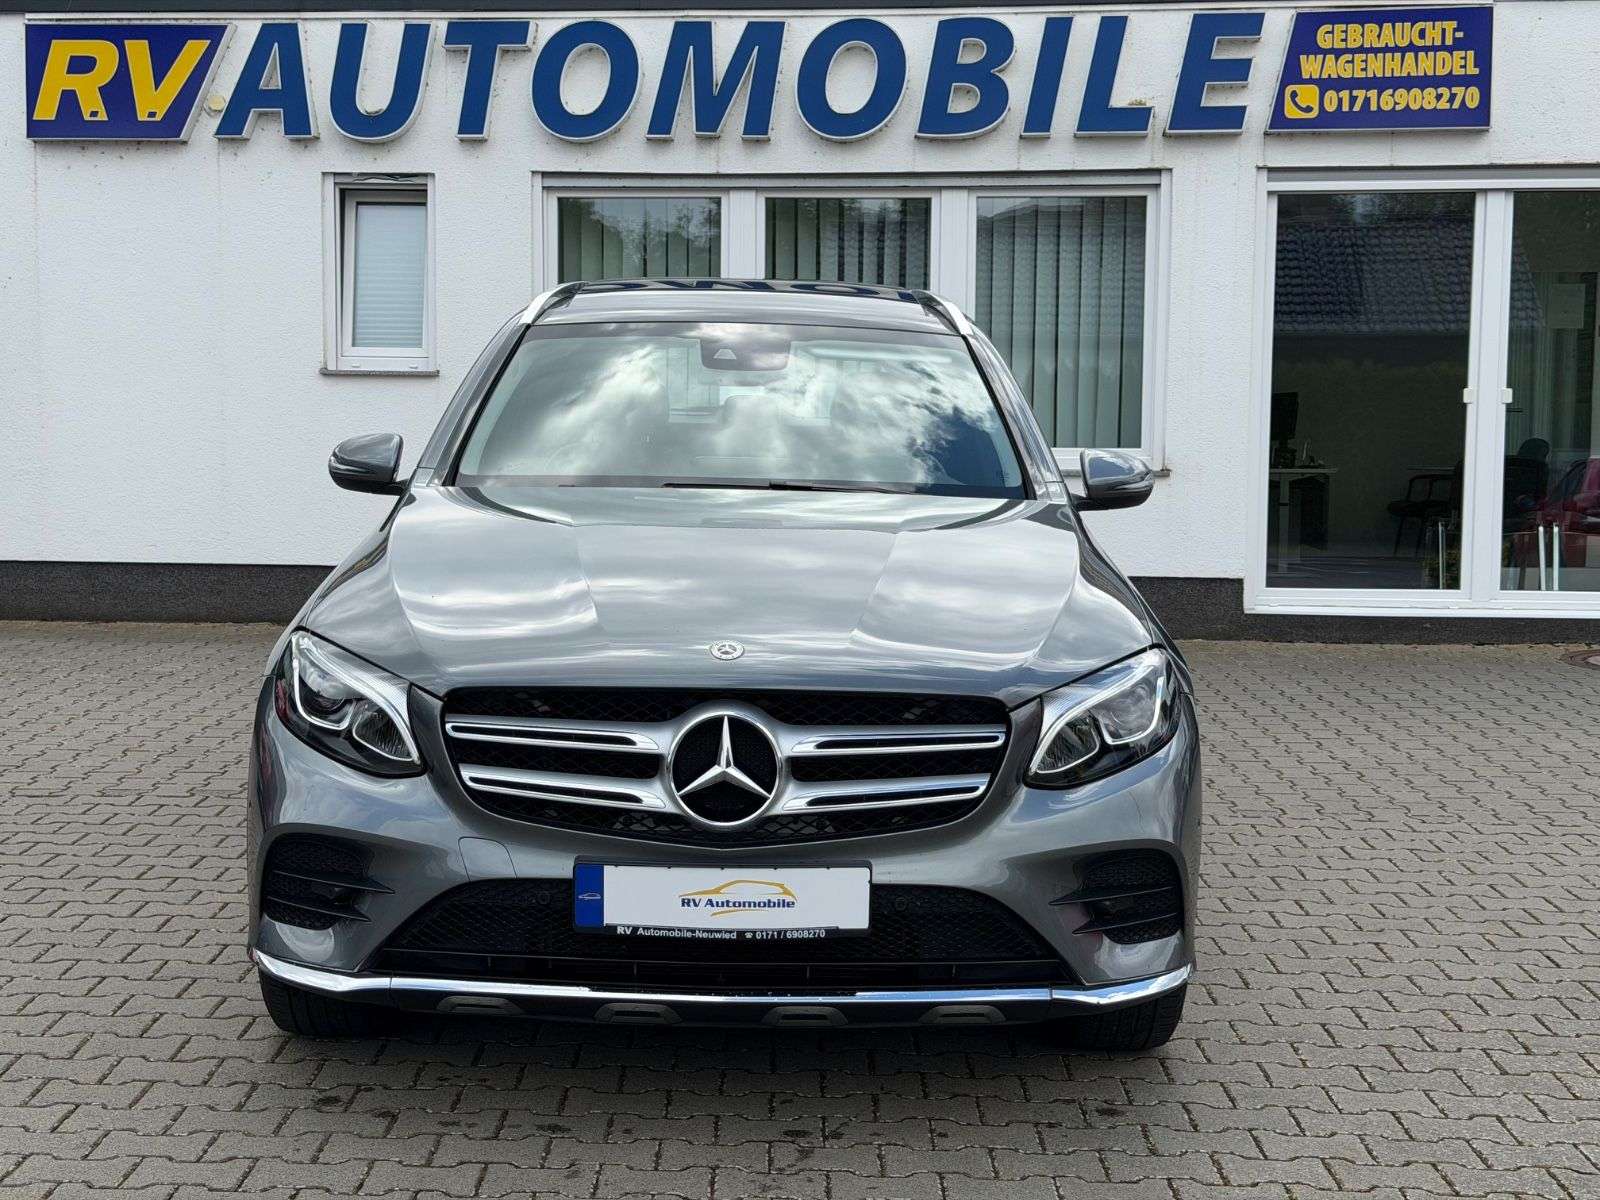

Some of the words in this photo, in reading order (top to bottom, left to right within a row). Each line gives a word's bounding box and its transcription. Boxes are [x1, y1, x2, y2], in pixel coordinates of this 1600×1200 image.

[1316, 20, 1464, 49] GEBRAUCHT-
[32, 39, 211, 121] RV
[213, 12, 1266, 142] AUTOMOBILE
[1299, 50, 1480, 79] WAGENHANDEL
[1323, 86, 1481, 112] 01716908270
[680, 897, 702, 909] RV
[704, 897, 796, 909] Automobile
[616, 925, 633, 936] RV
[637, 928, 737, 939] Automobile-Neuwied
[755, 931, 778, 939] 0171
[786, 930, 826, 939] 6908270
